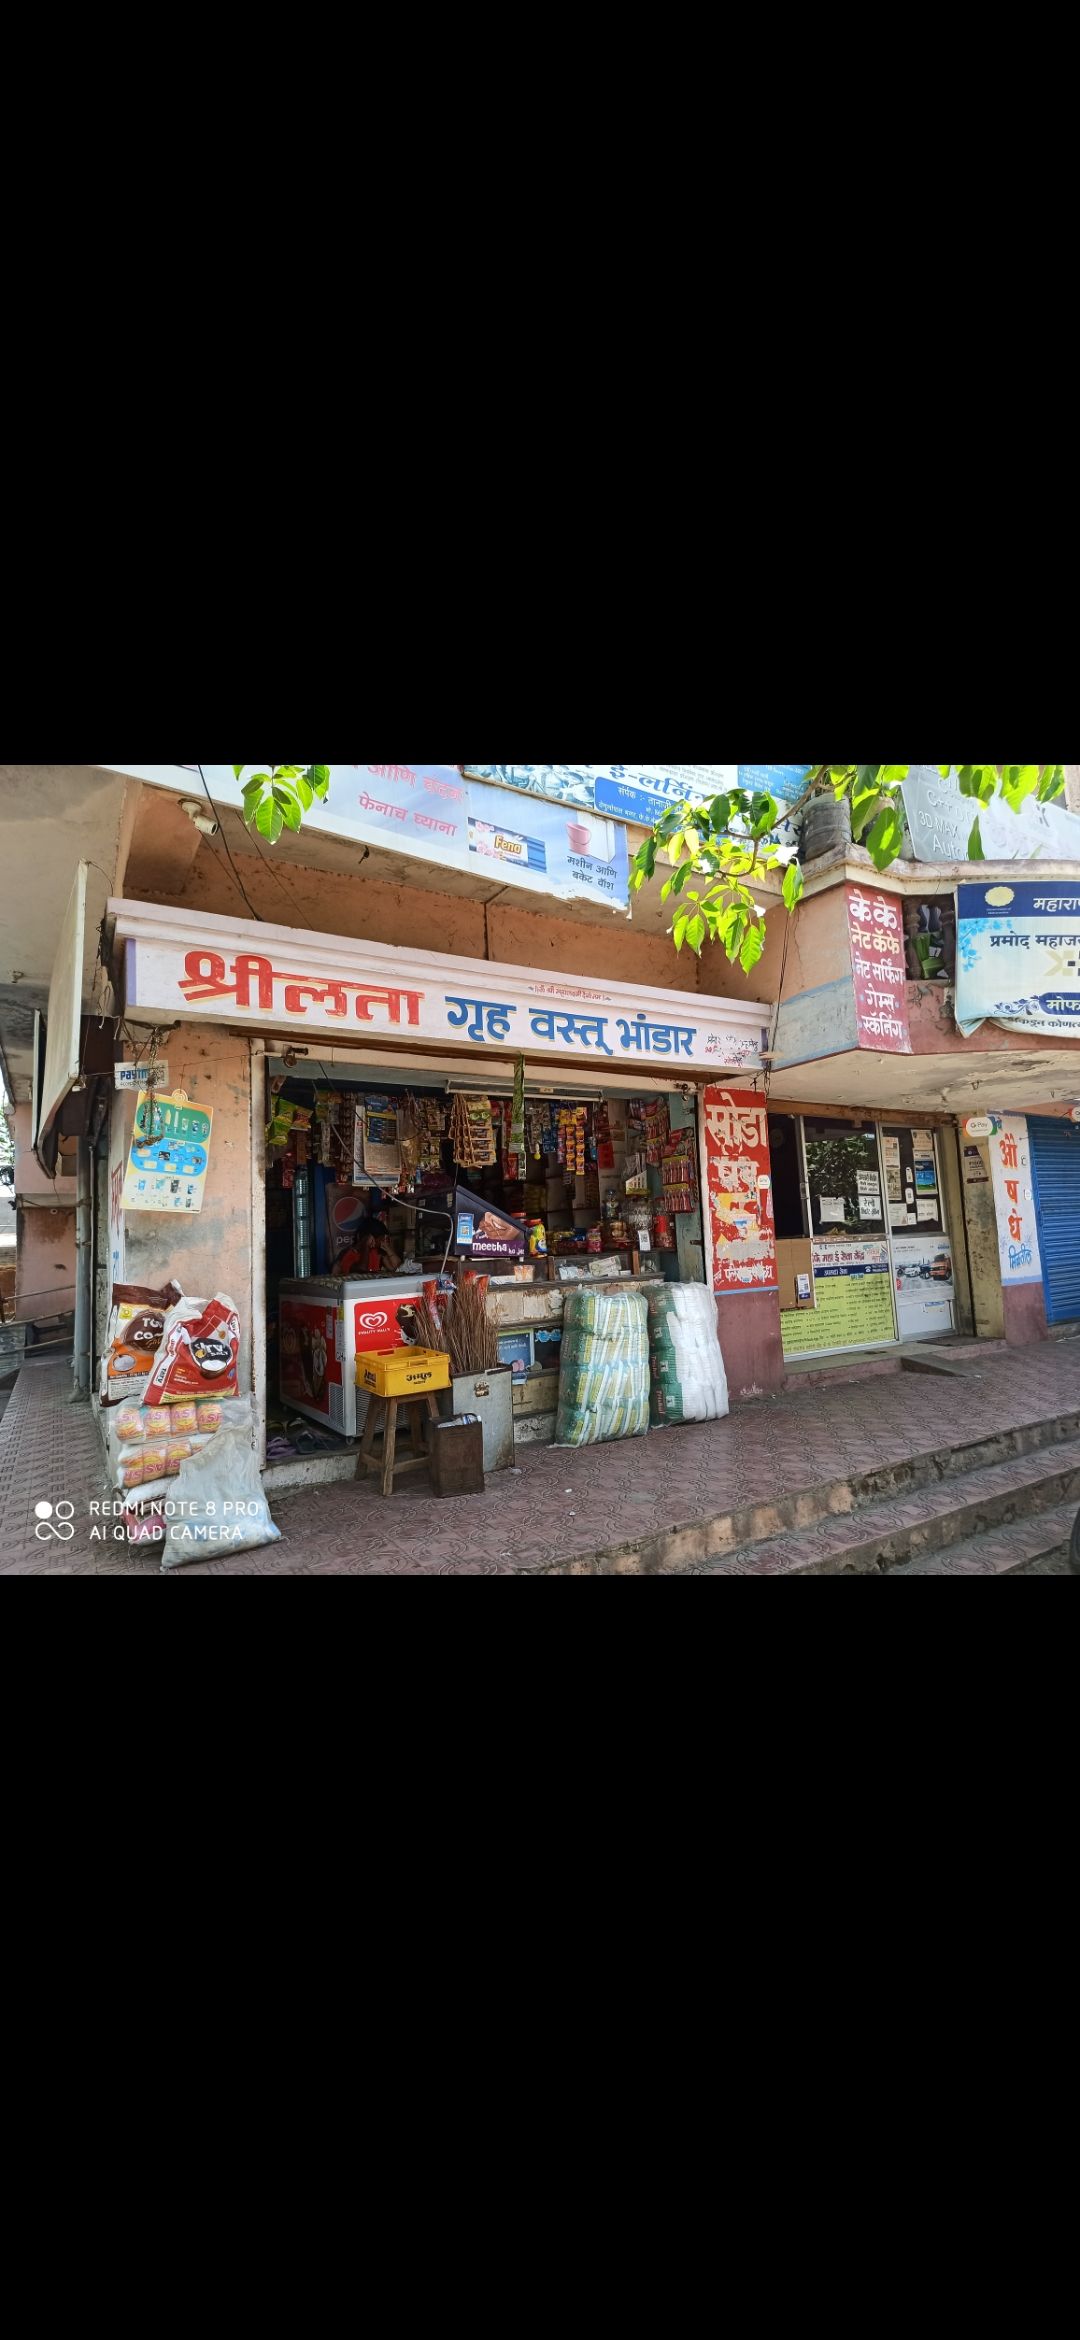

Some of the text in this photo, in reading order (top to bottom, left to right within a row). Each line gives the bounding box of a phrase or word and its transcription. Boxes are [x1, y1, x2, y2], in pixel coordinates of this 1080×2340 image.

[359, 791, 409, 821] फेनाच
[494, 835, 522, 855] Fena
[567, 856, 618, 878] मशीन आणि
[572, 870, 593, 883] बकेट
[851, 922, 900, 954] नेट कॅफे
[990, 930, 1031, 949] प्रमोद
[855, 953, 871, 979] नेट
[178, 950, 425, 1025] श्रीलता
[445, 996, 517, 1042] गृह
[528, 1007, 613, 1056] वस्तू
[616, 1013, 697, 1056] भांडार
[120, 1069, 147, 1080] Paytm
[705, 1091, 768, 1148] सोडा
[472, 1241, 507, 1252] meetha
